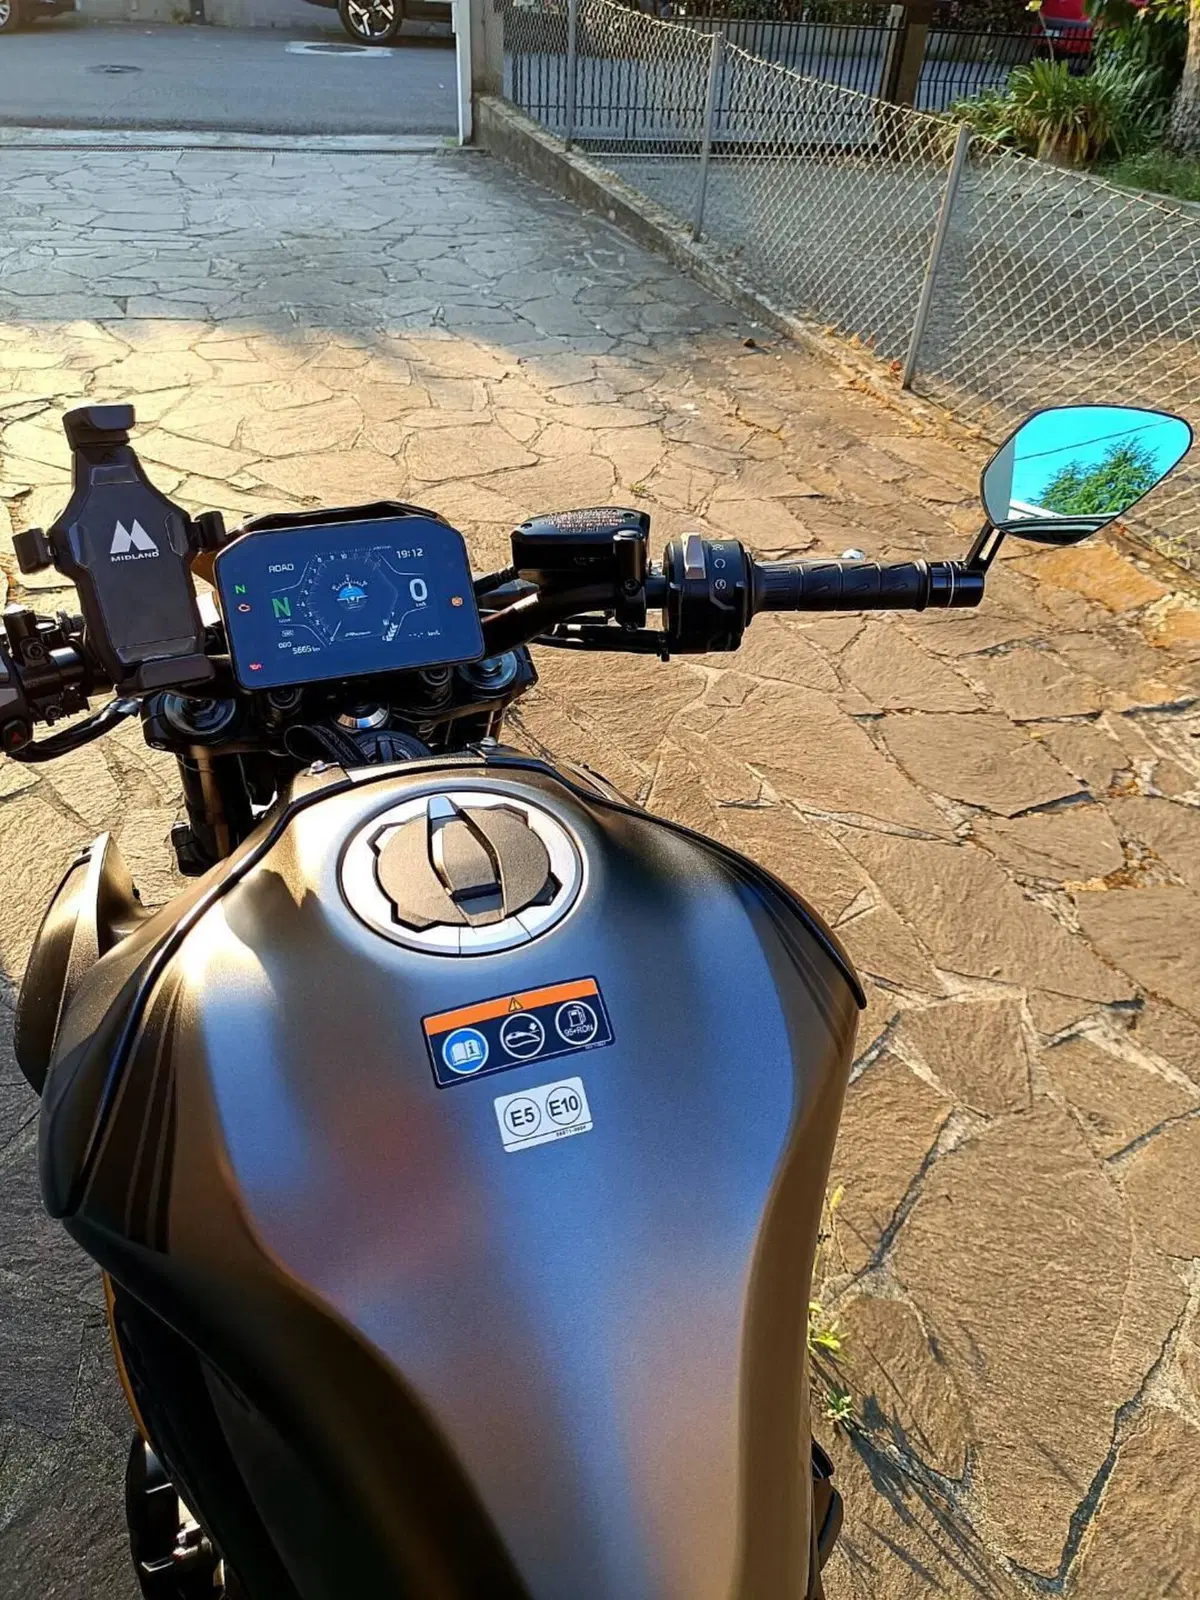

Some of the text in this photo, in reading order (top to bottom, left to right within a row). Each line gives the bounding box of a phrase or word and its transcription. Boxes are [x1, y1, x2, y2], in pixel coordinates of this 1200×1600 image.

[111, 551, 159, 562] MIDLAND
[396, 547, 424, 559] 19:12
[268, 563, 294, 573] ROAD
[235, 584, 247, 594] N
[409, 578, 428, 601] 0
[271, 597, 292, 618] N
[510, 1095, 579, 1128] E5 E10
